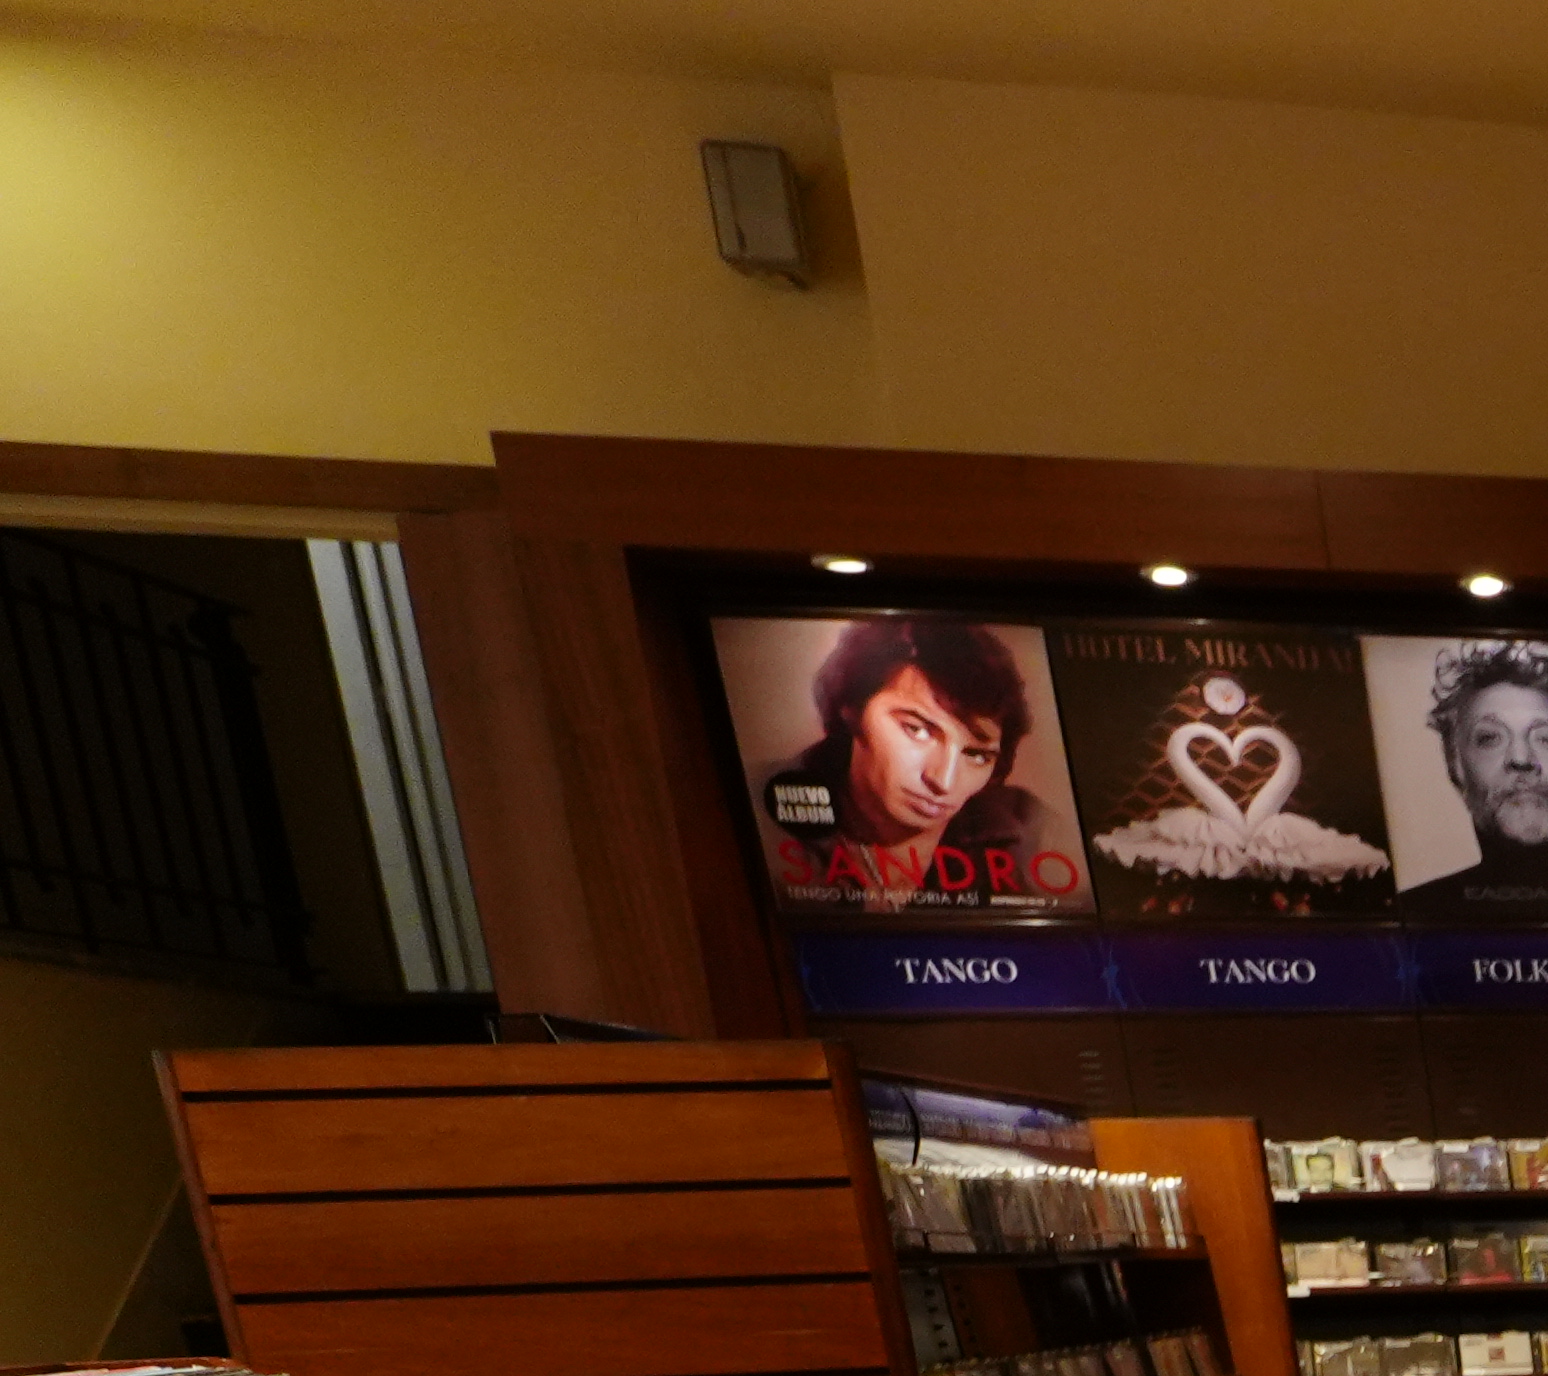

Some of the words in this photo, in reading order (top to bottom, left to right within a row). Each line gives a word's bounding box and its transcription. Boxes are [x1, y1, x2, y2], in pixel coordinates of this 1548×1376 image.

[774, 785, 830, 805] NUEVO
[778, 841, 1077, 895] SANDRO
[896, 957, 1018, 984] TANGO
[1200, 957, 1316, 984] TANGO
